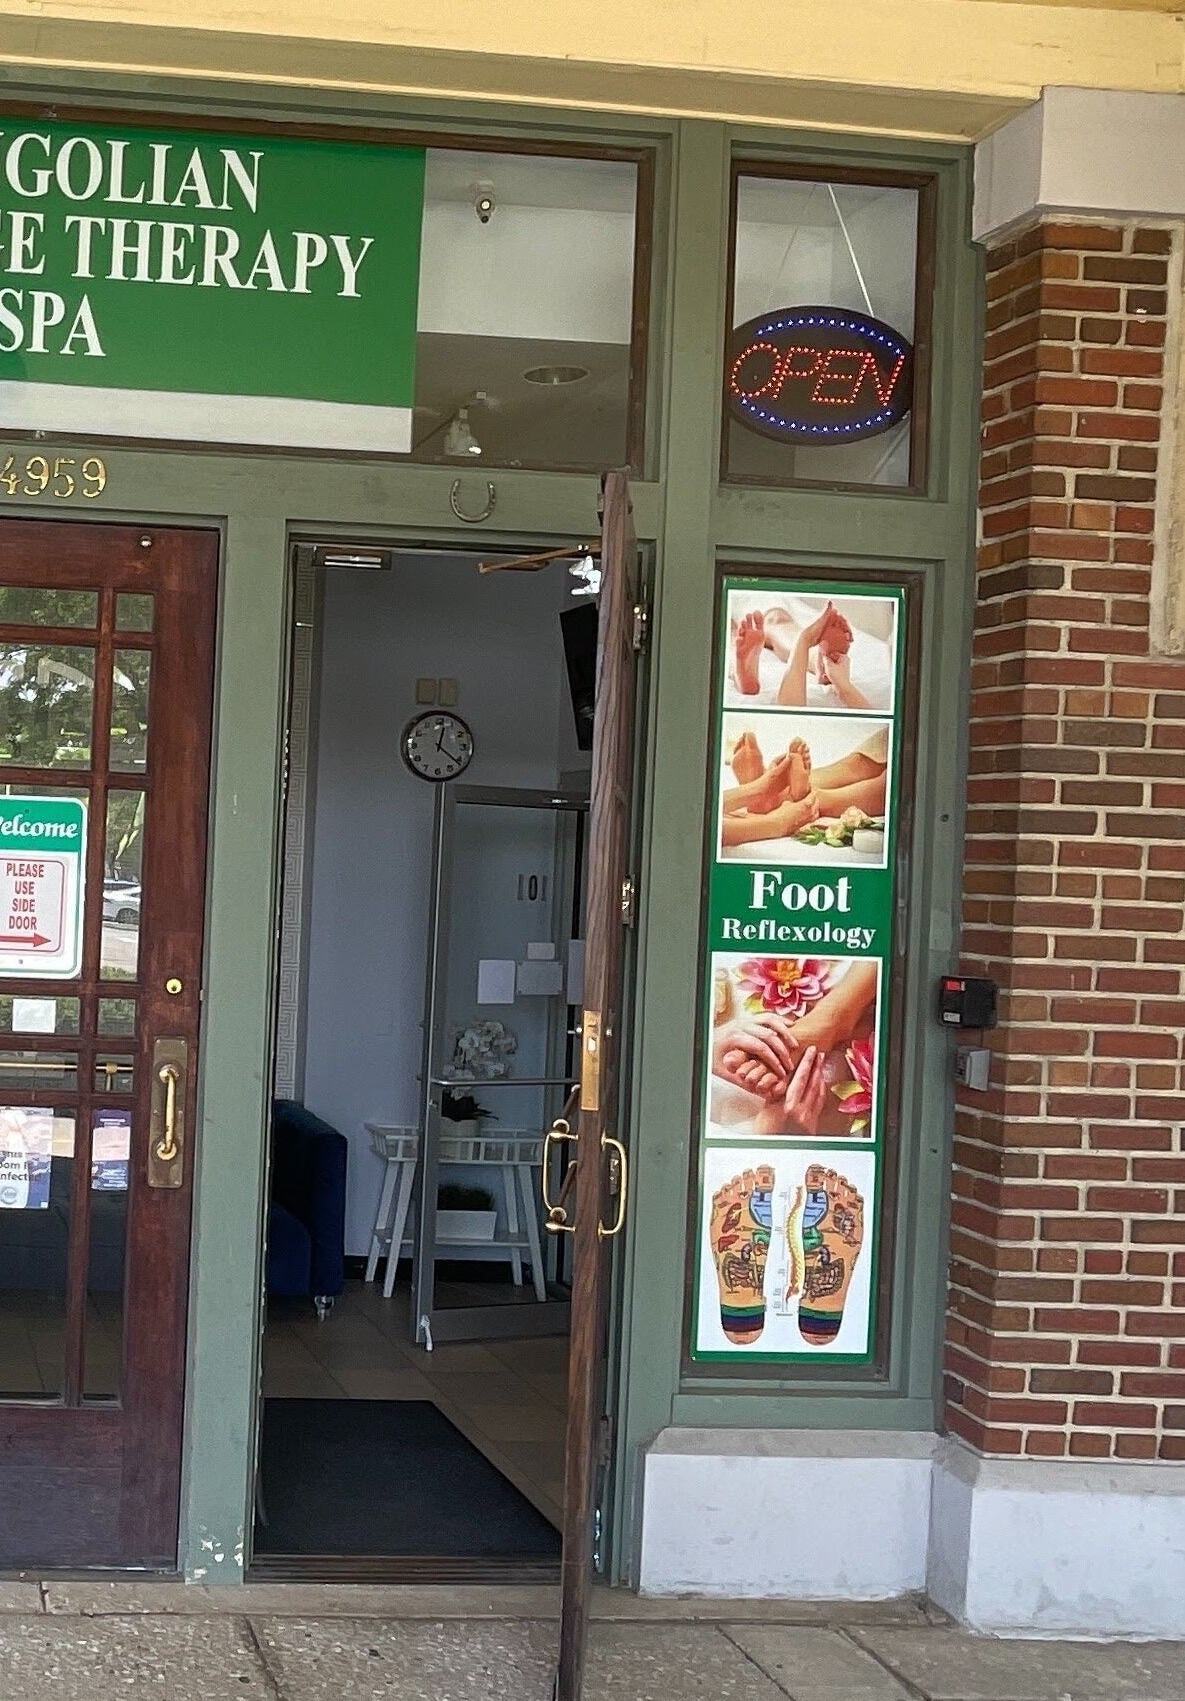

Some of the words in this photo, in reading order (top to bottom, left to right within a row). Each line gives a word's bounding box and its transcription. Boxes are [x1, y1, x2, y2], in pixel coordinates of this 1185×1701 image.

[63, 214, 376, 299] THERAPY
[729, 342, 907, 407] OPEN
[5, 862, 45, 879] PLEASE
[14, 880, 36, 896] USE
[748, 870, 853, 913] Foot
[11, 898, 36, 913] SIDE
[8, 915, 38, 931] DOOR
[721, 917, 876, 949] Reflexology
